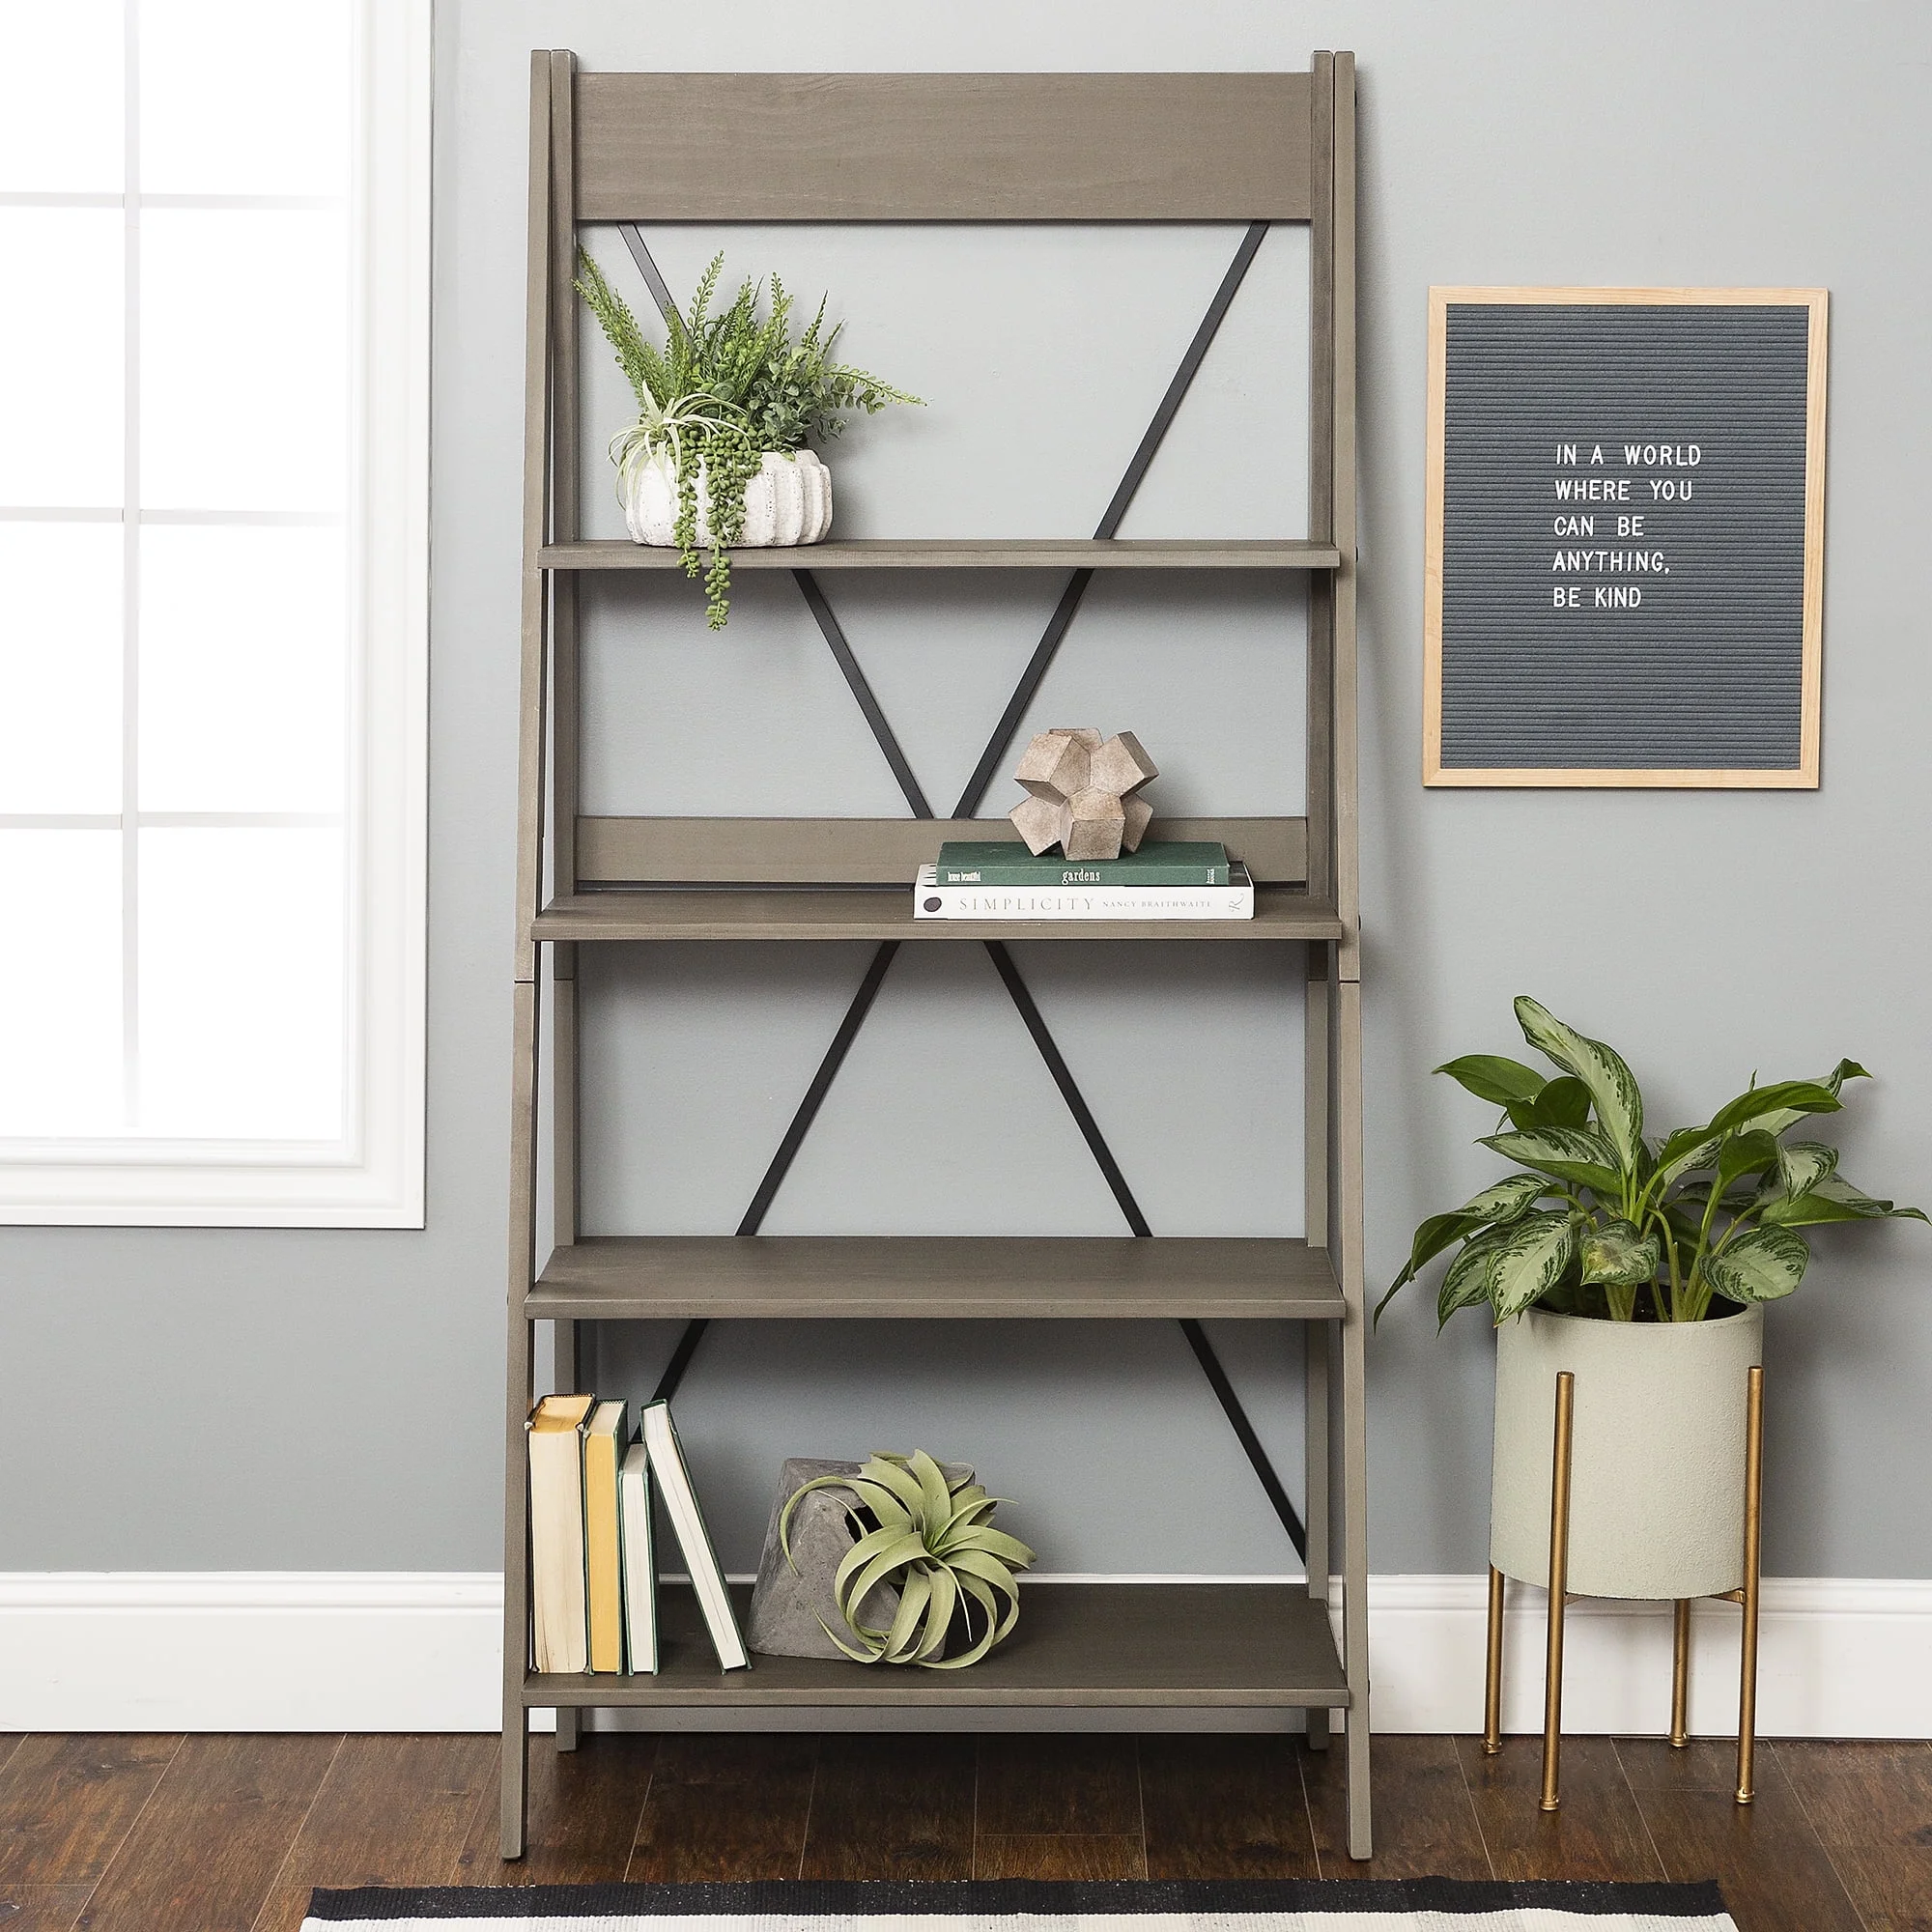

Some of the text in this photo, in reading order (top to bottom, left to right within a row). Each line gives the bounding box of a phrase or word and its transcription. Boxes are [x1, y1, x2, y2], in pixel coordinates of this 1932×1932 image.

[1556, 444, 1701, 466] IN A WORLD
[1554, 479, 1692, 501] WHERE YOU
[1553, 516, 1645, 536] CAN BE
[1552, 551, 1670, 574] ANYTHING,
[1553, 586, 1641, 609] BE KIND
[1062, 868, 1100, 885] gardens
[959, 898, 1094, 910] SIMPLICITY
